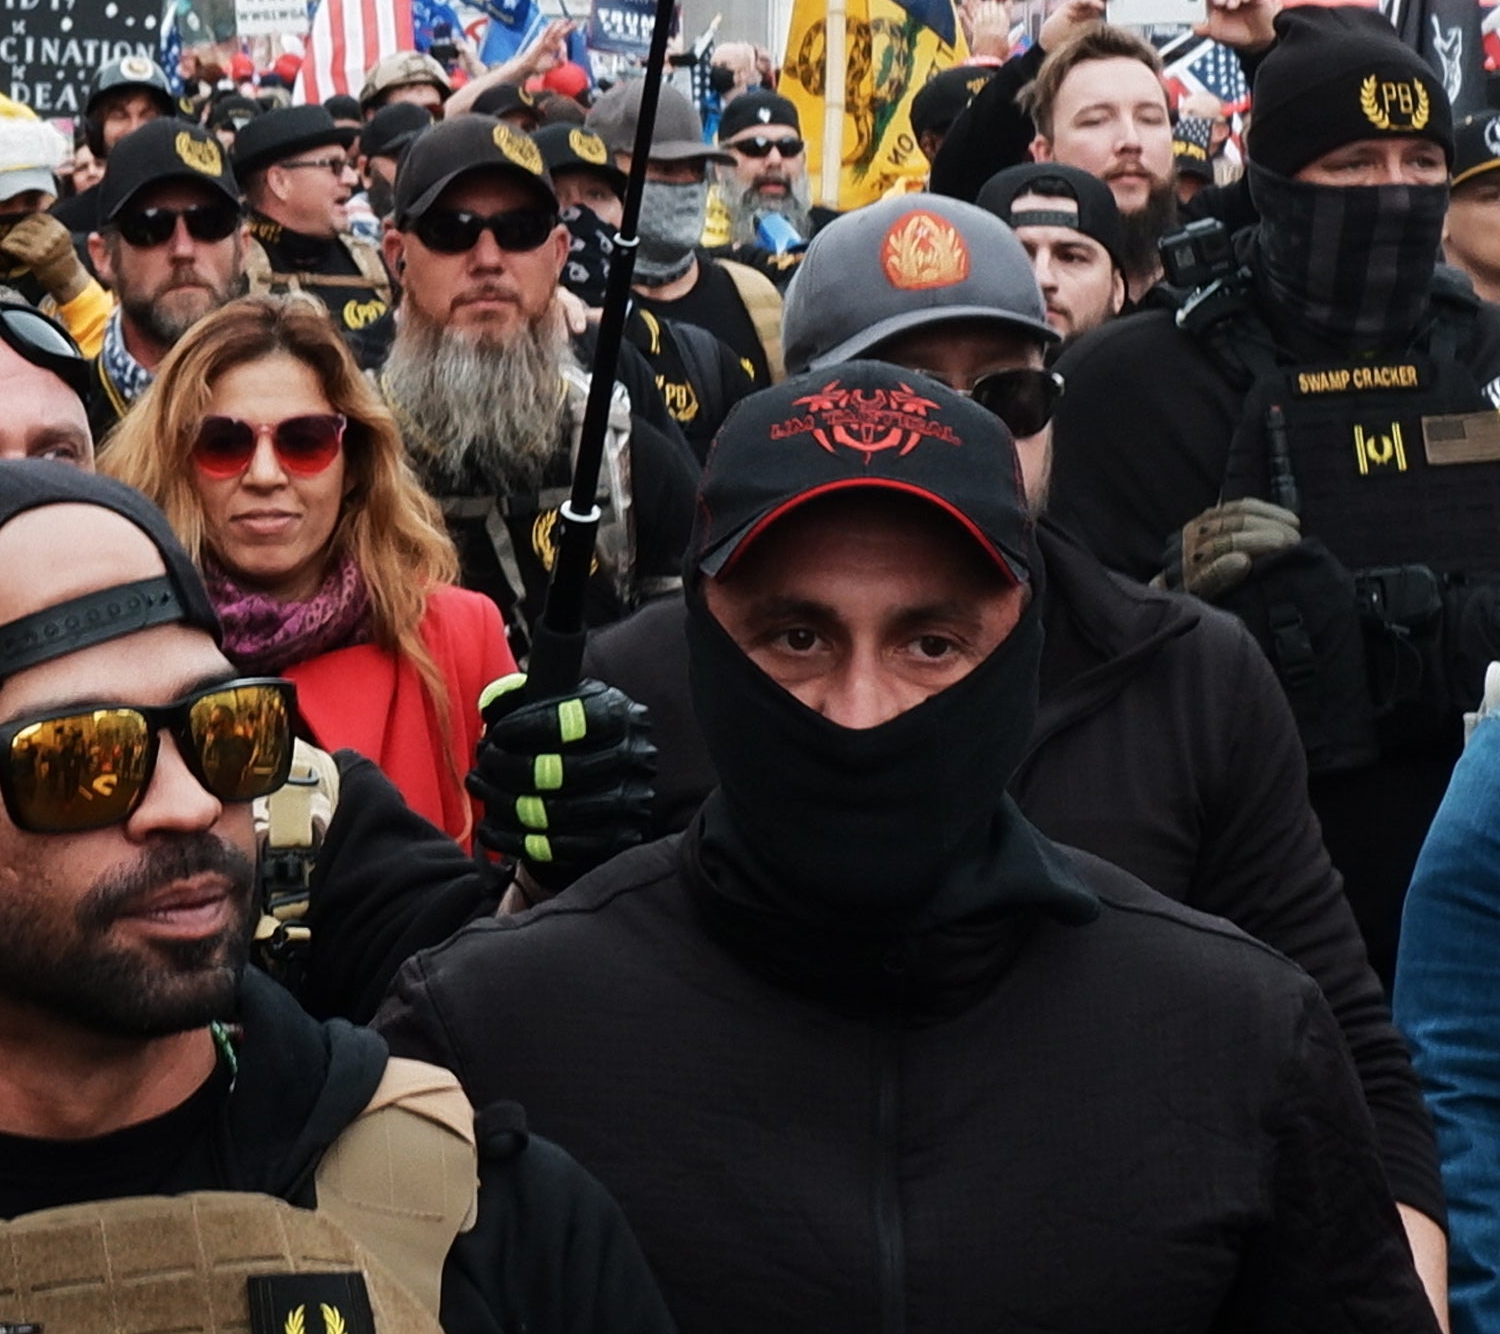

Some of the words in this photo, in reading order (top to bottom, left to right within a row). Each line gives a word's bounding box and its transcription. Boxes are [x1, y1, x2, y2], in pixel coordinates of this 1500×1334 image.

[1382, 82, 1414, 116] PB
[1298, 370, 1351, 394] SWAMP
[1352, 365, 1419, 389] CRACKER
